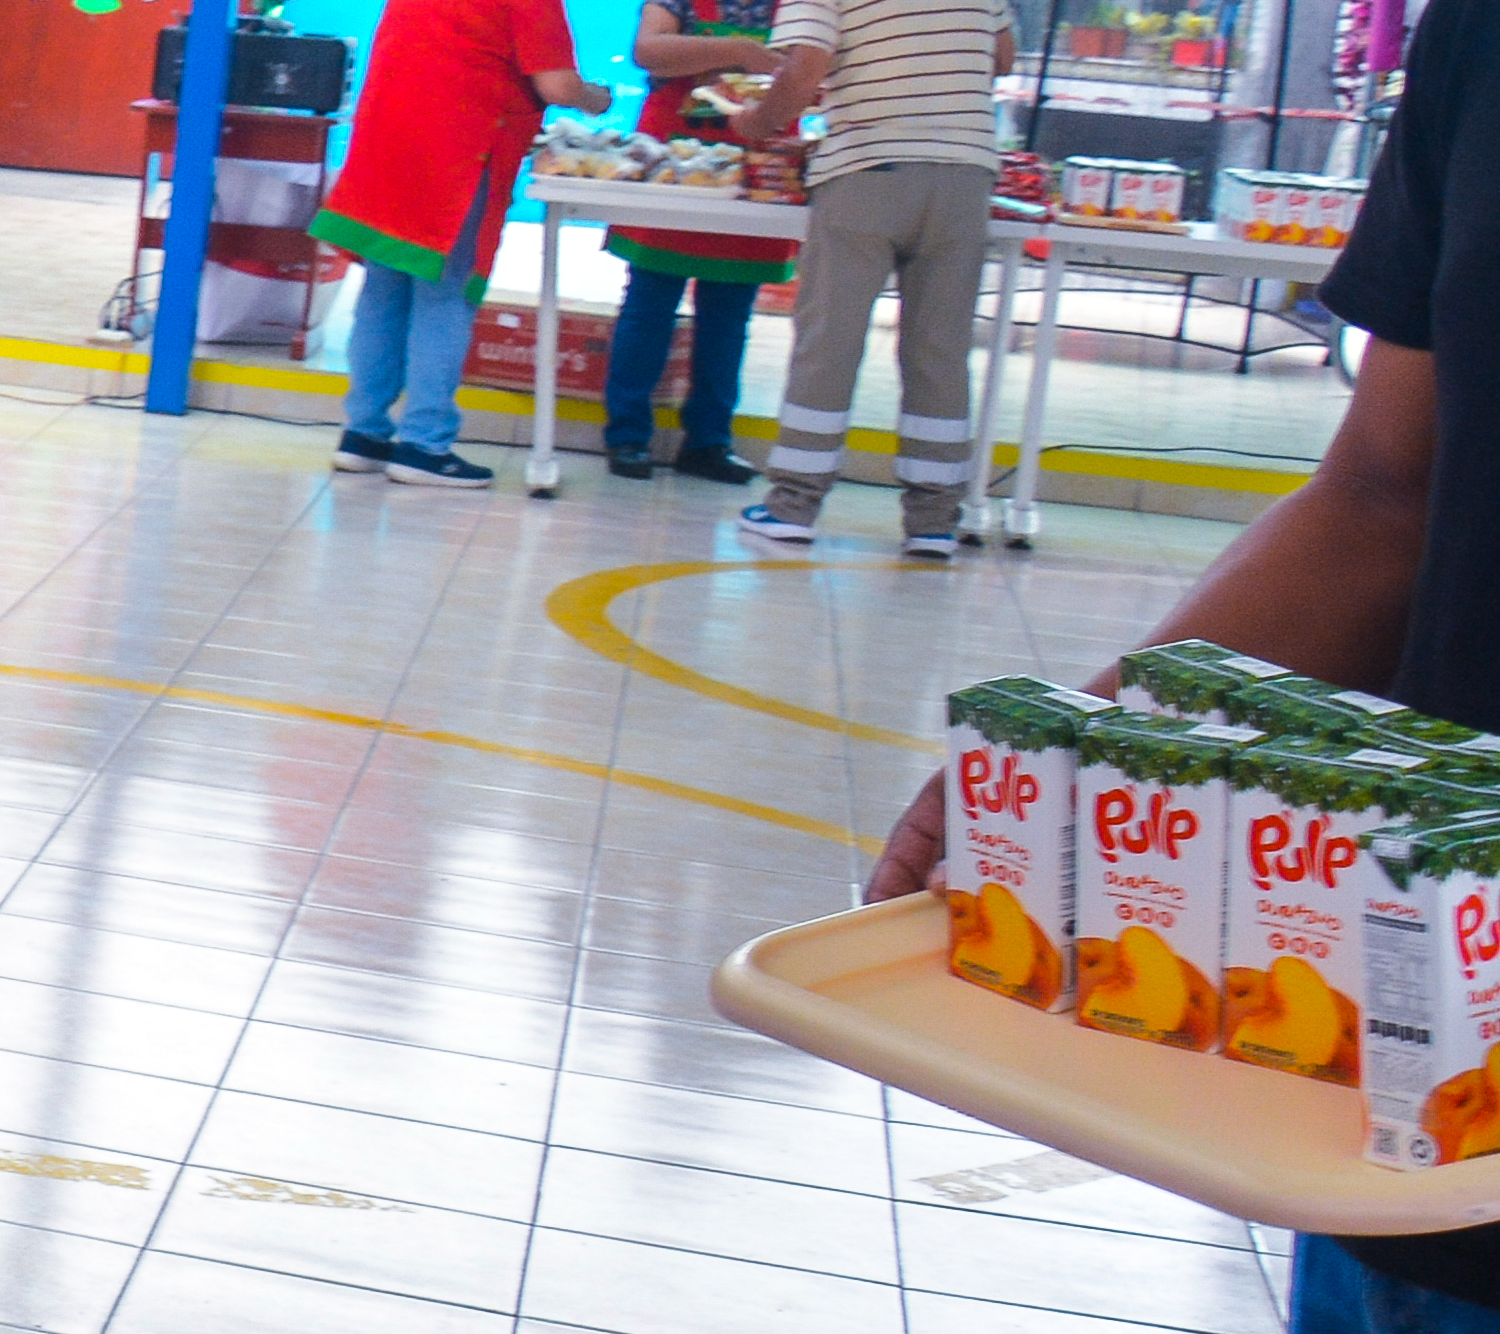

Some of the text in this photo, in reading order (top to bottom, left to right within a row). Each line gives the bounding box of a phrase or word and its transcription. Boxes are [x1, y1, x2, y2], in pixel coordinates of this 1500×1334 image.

[959, 746, 1041, 822] Pulp
[1093, 786, 1200, 864] Pulp
[1248, 810, 1357, 891] Pulp
